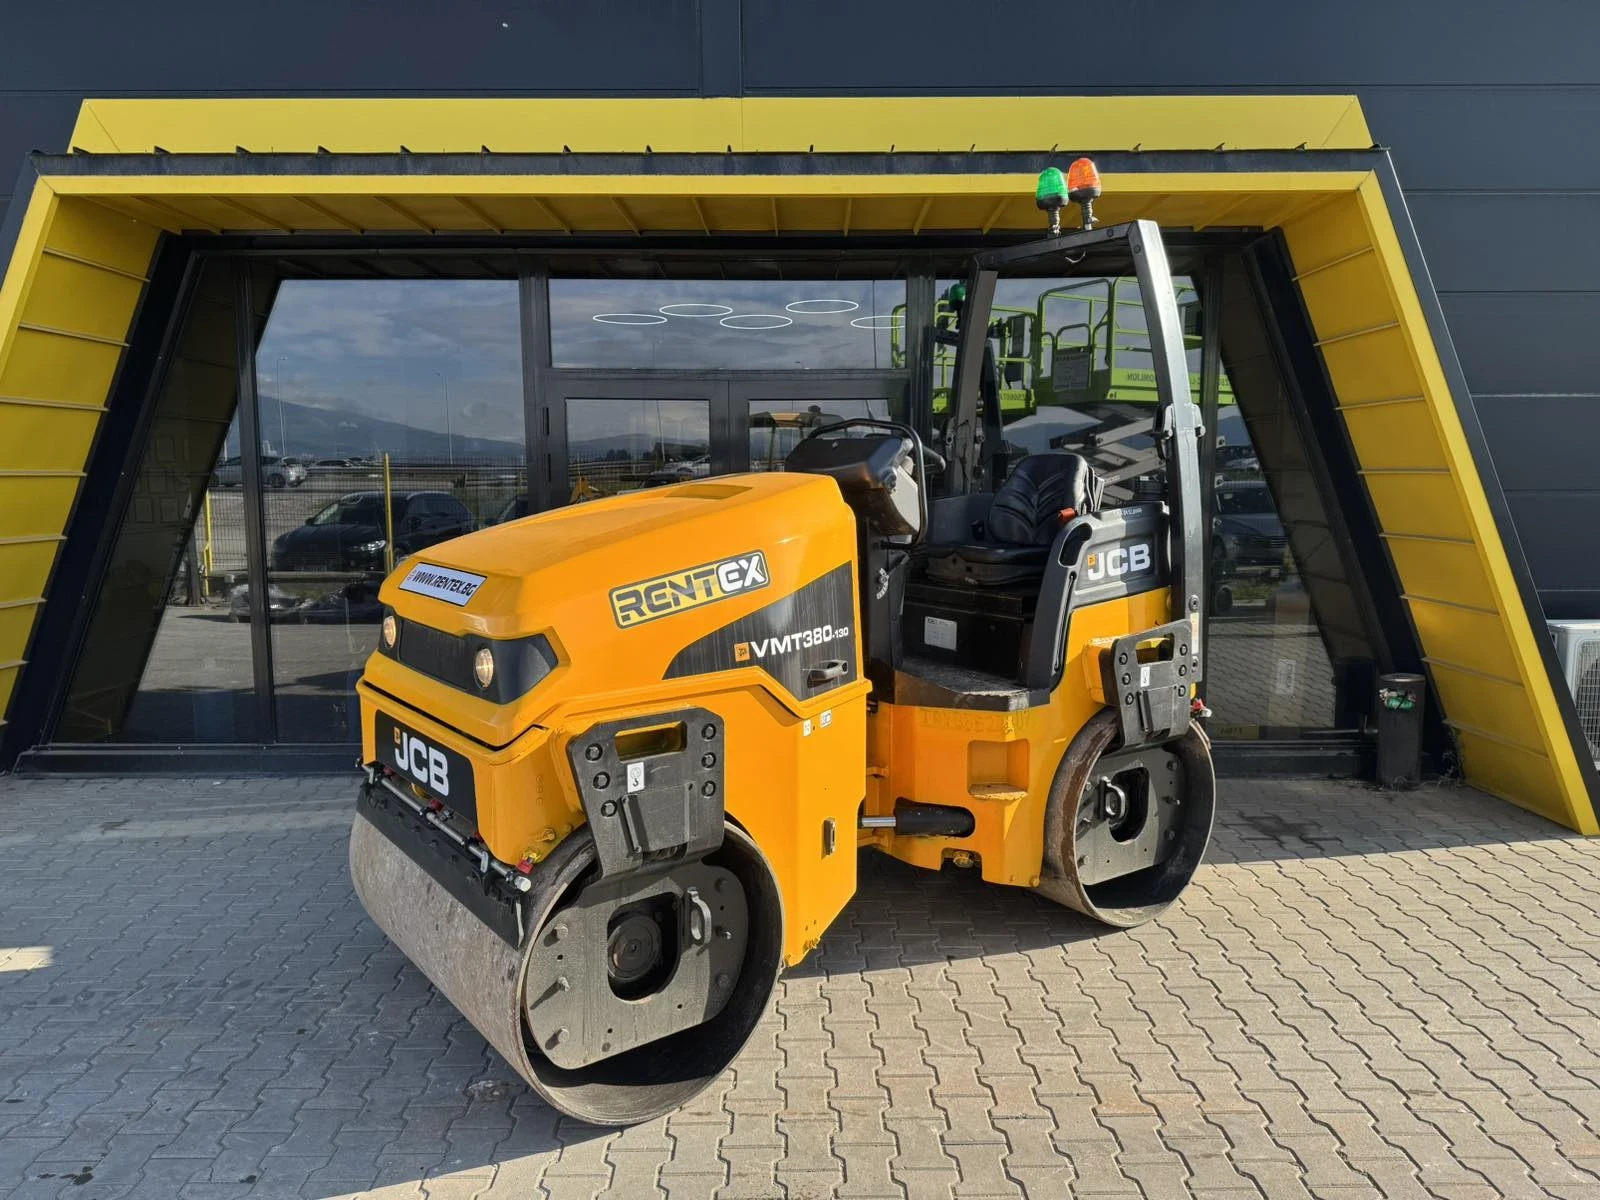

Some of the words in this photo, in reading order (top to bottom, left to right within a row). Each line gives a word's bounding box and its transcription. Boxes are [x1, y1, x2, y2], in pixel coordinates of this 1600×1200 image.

[411, 571, 479, 597] WWW.RENTEX.BG
[1087, 543, 1151, 581] JCB
[616, 554, 767, 623] RENTEX
[395, 731, 449, 797] JCB
